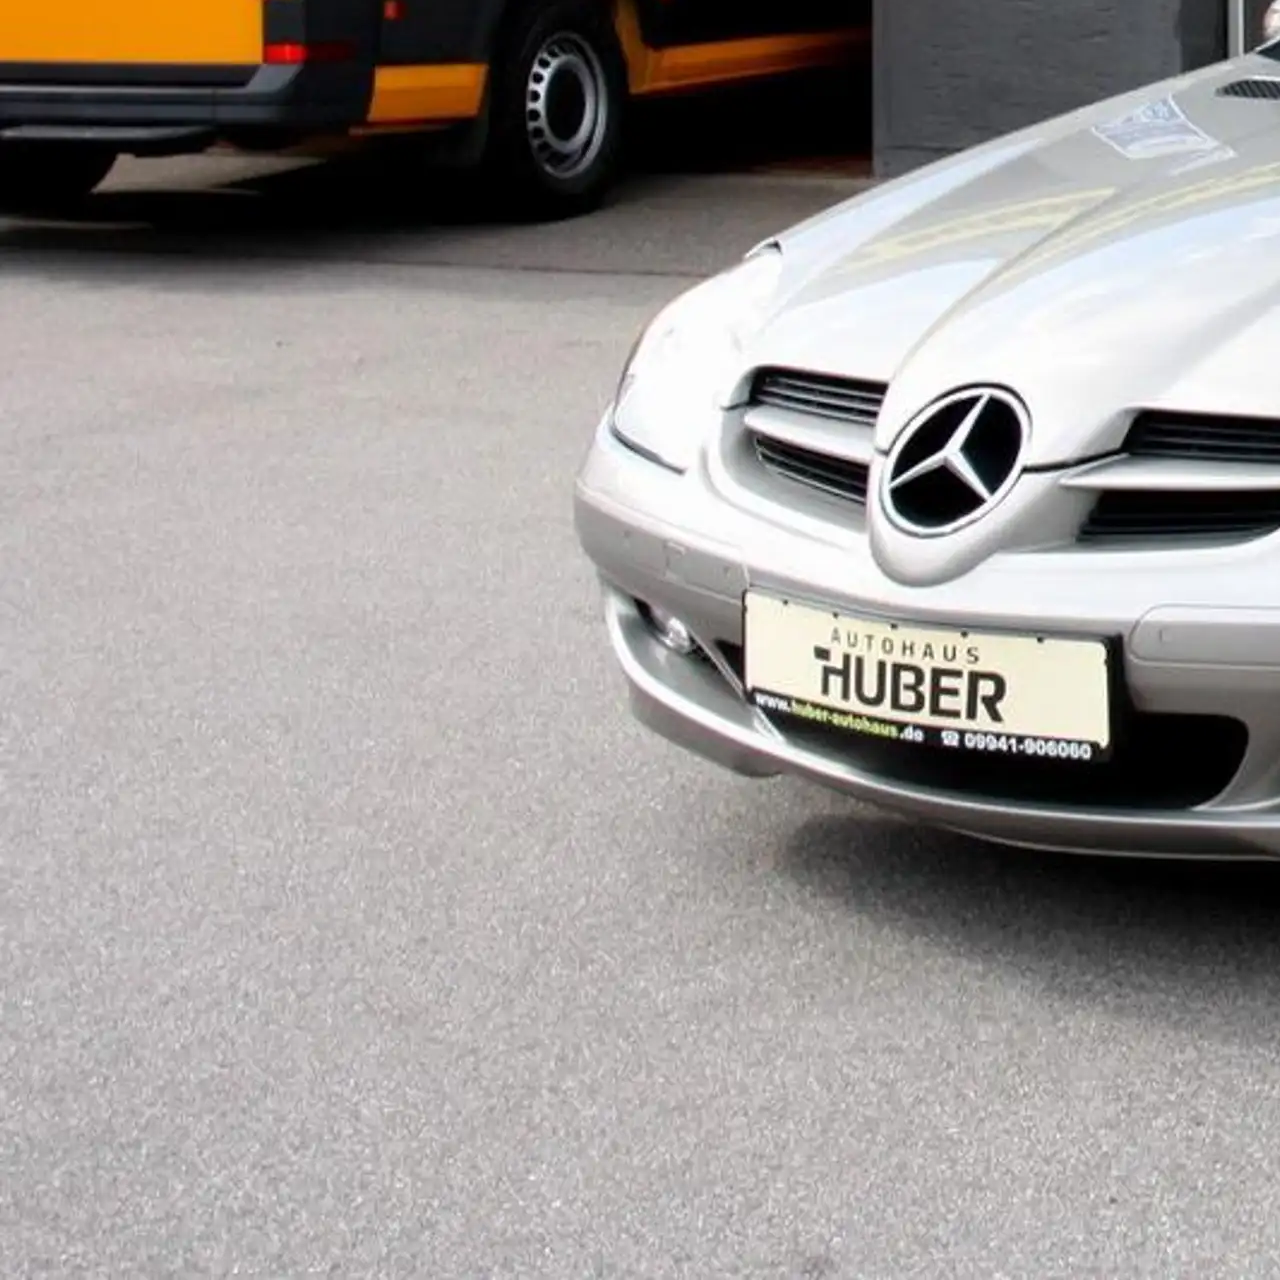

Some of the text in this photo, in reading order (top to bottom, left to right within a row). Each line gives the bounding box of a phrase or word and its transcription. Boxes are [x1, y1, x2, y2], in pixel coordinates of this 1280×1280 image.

[830, 626, 981, 664] AUTOHAUS
[813, 646, 1007, 724] HUBER
[754, 691, 925, 743] www.huber-autohaus.de
